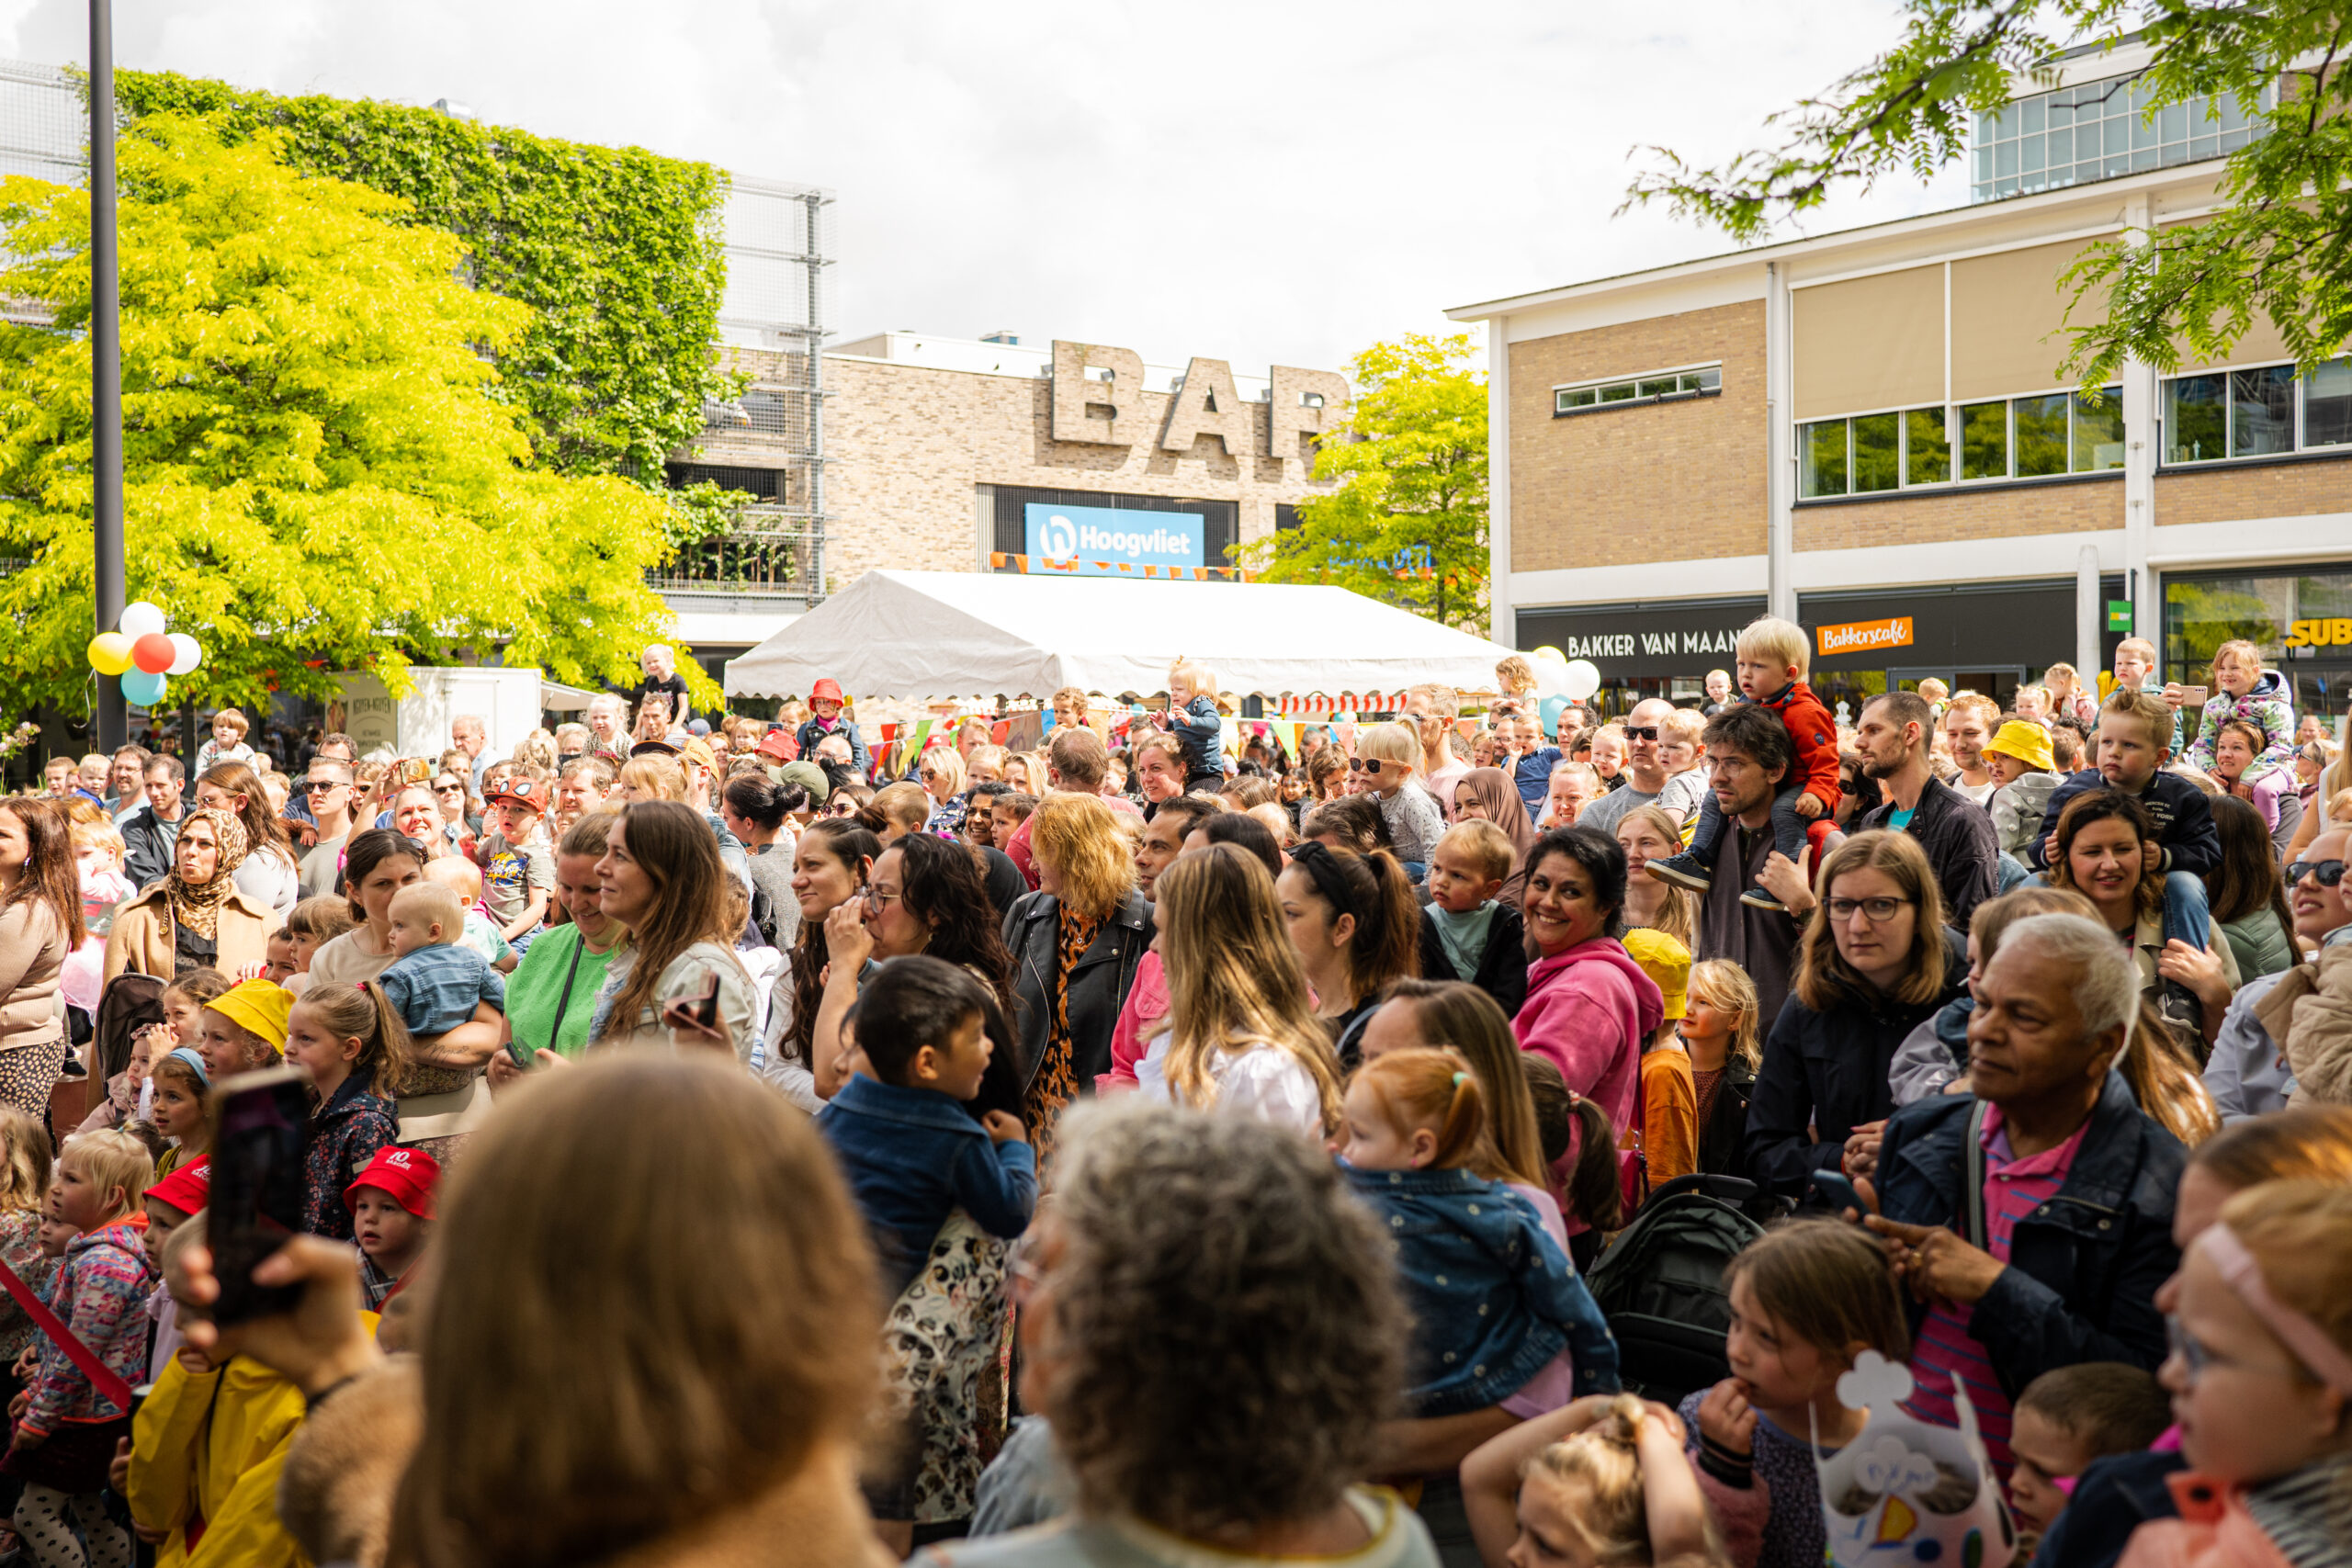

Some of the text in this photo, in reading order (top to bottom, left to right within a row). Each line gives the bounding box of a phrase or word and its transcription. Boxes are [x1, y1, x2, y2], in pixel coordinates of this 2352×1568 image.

[1080, 525, 1192, 558] Hoogvliet
[1567, 628, 1744, 659] BAKKER VAN MAAN
[1824, 618, 1907, 650] Bakkerscafé
[2284, 617, 2352, 649] SUB
[2156, 813, 2176, 821] YORK
[389, 1151, 411, 1163] 10
